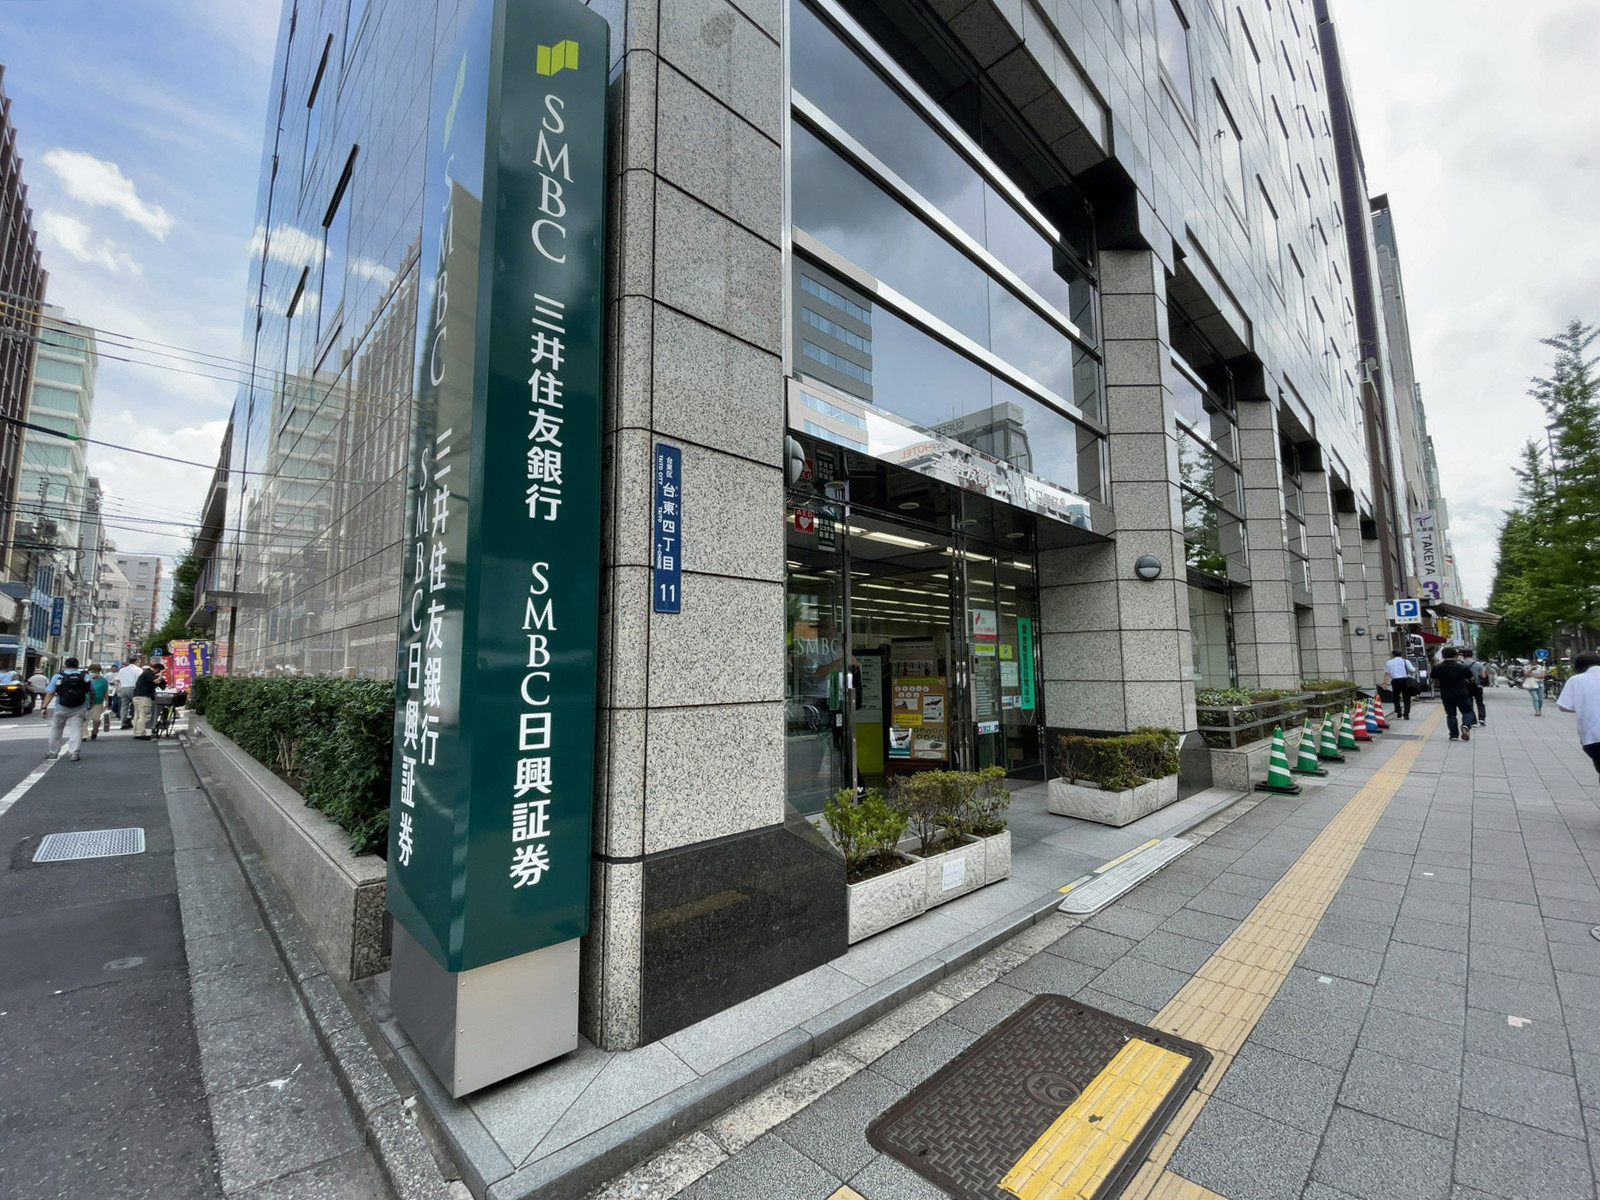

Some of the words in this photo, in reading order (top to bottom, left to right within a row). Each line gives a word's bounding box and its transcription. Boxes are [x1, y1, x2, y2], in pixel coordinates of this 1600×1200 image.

[532, 94, 574, 264] SMBC
[430, 153, 455, 387] SMBC
[525, 292, 565, 522] 三井住友銀行
[662, 482, 676, 571] 台東四丁目
[796, 508, 813, 518] AED
[1421, 534, 1435, 575] TAKEYA
[420, 428, 452, 766] 三井住友銀行
[660, 583, 675, 602] 11
[1400, 602, 1413, 616] P
[1423, 581, 1440, 600] 3
[398, 447, 428, 867] SMBC日興証券
[797, 636, 841, 655] SMBC
[509, 561, 557, 889] SMBC日興証券
